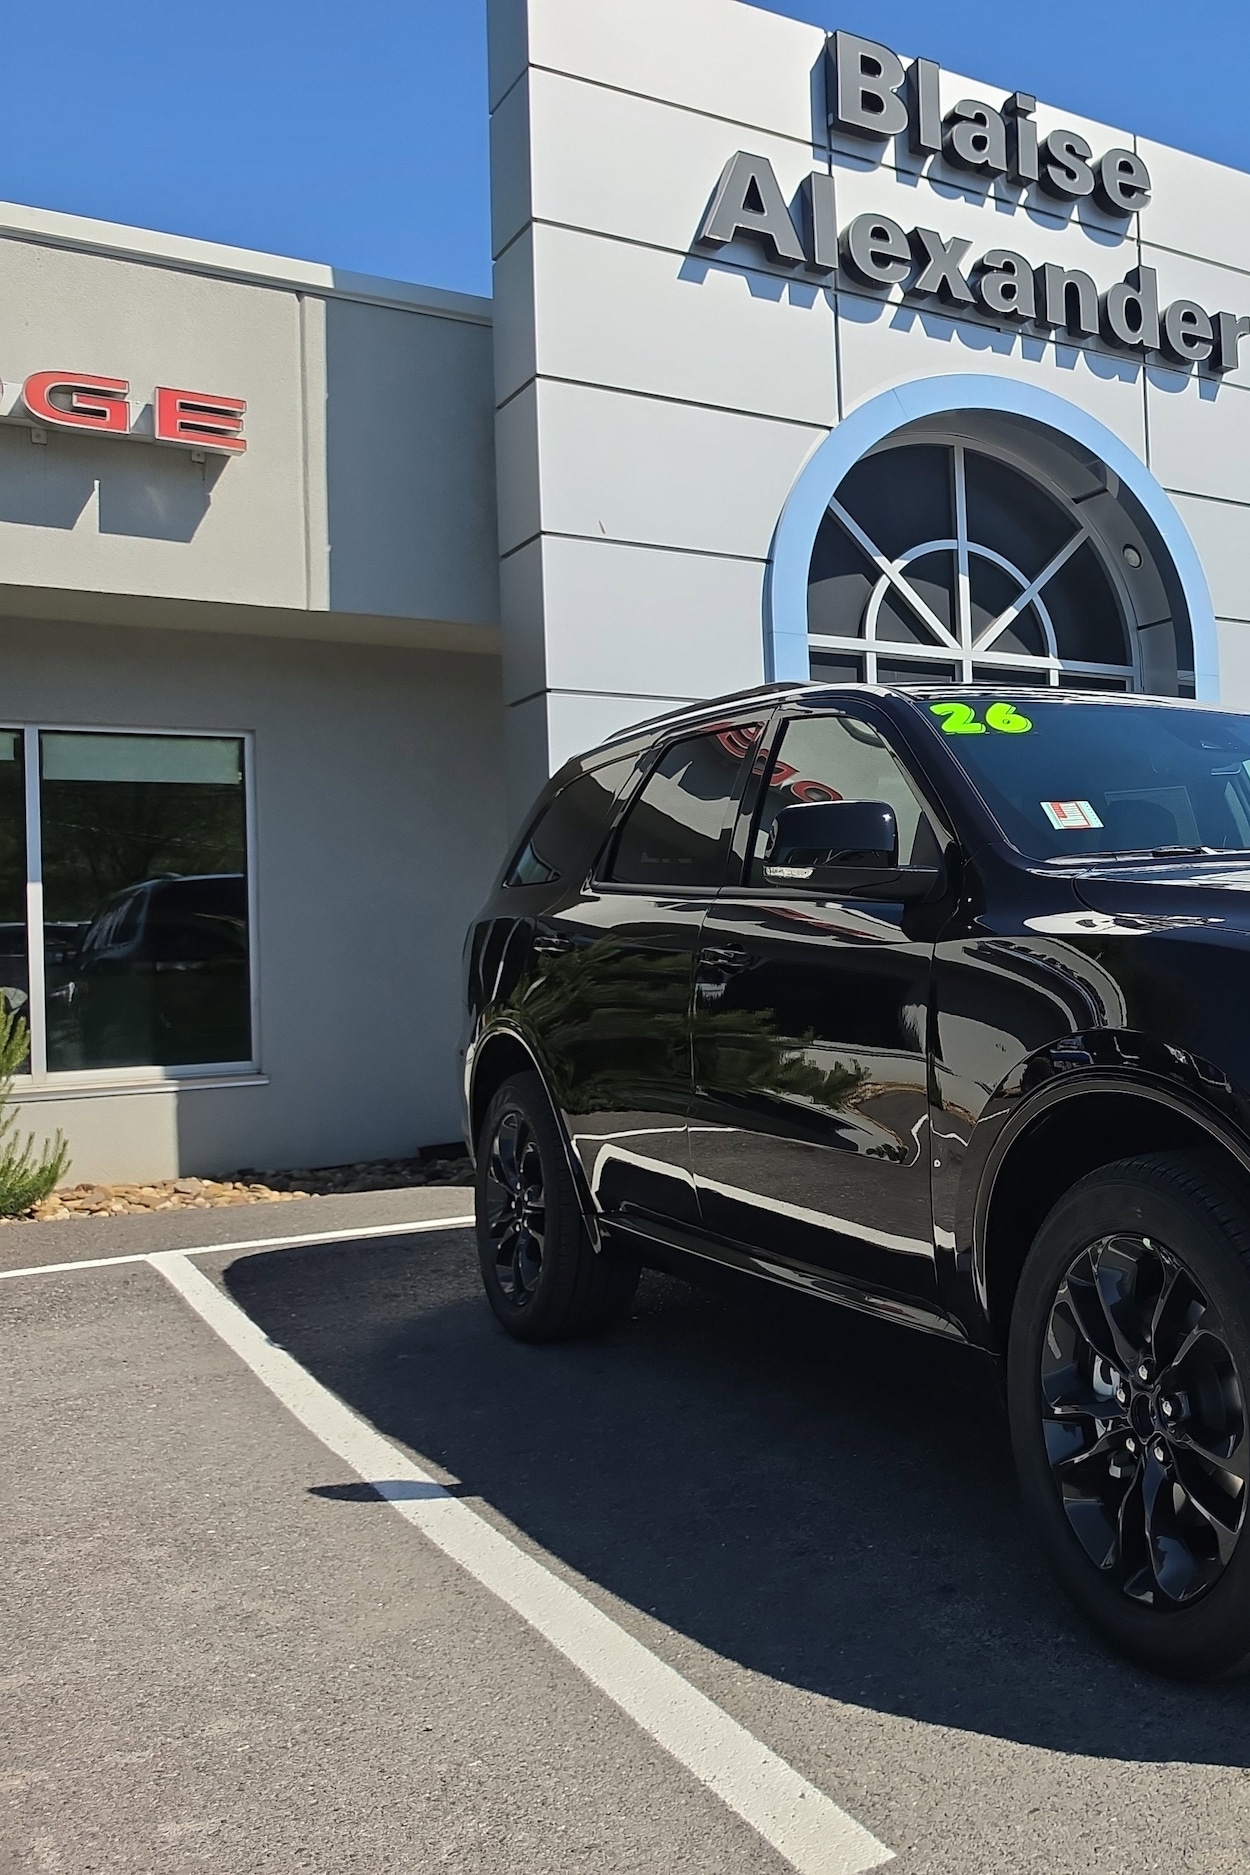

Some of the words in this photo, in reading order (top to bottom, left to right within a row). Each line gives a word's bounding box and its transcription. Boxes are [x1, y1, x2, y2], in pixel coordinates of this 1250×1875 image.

[828, 30, 1151, 218] Blaise
[701, 150, 1250, 373] Alexander
[0, 369, 247, 455] GE
[929, 702, 1033, 733] 26
